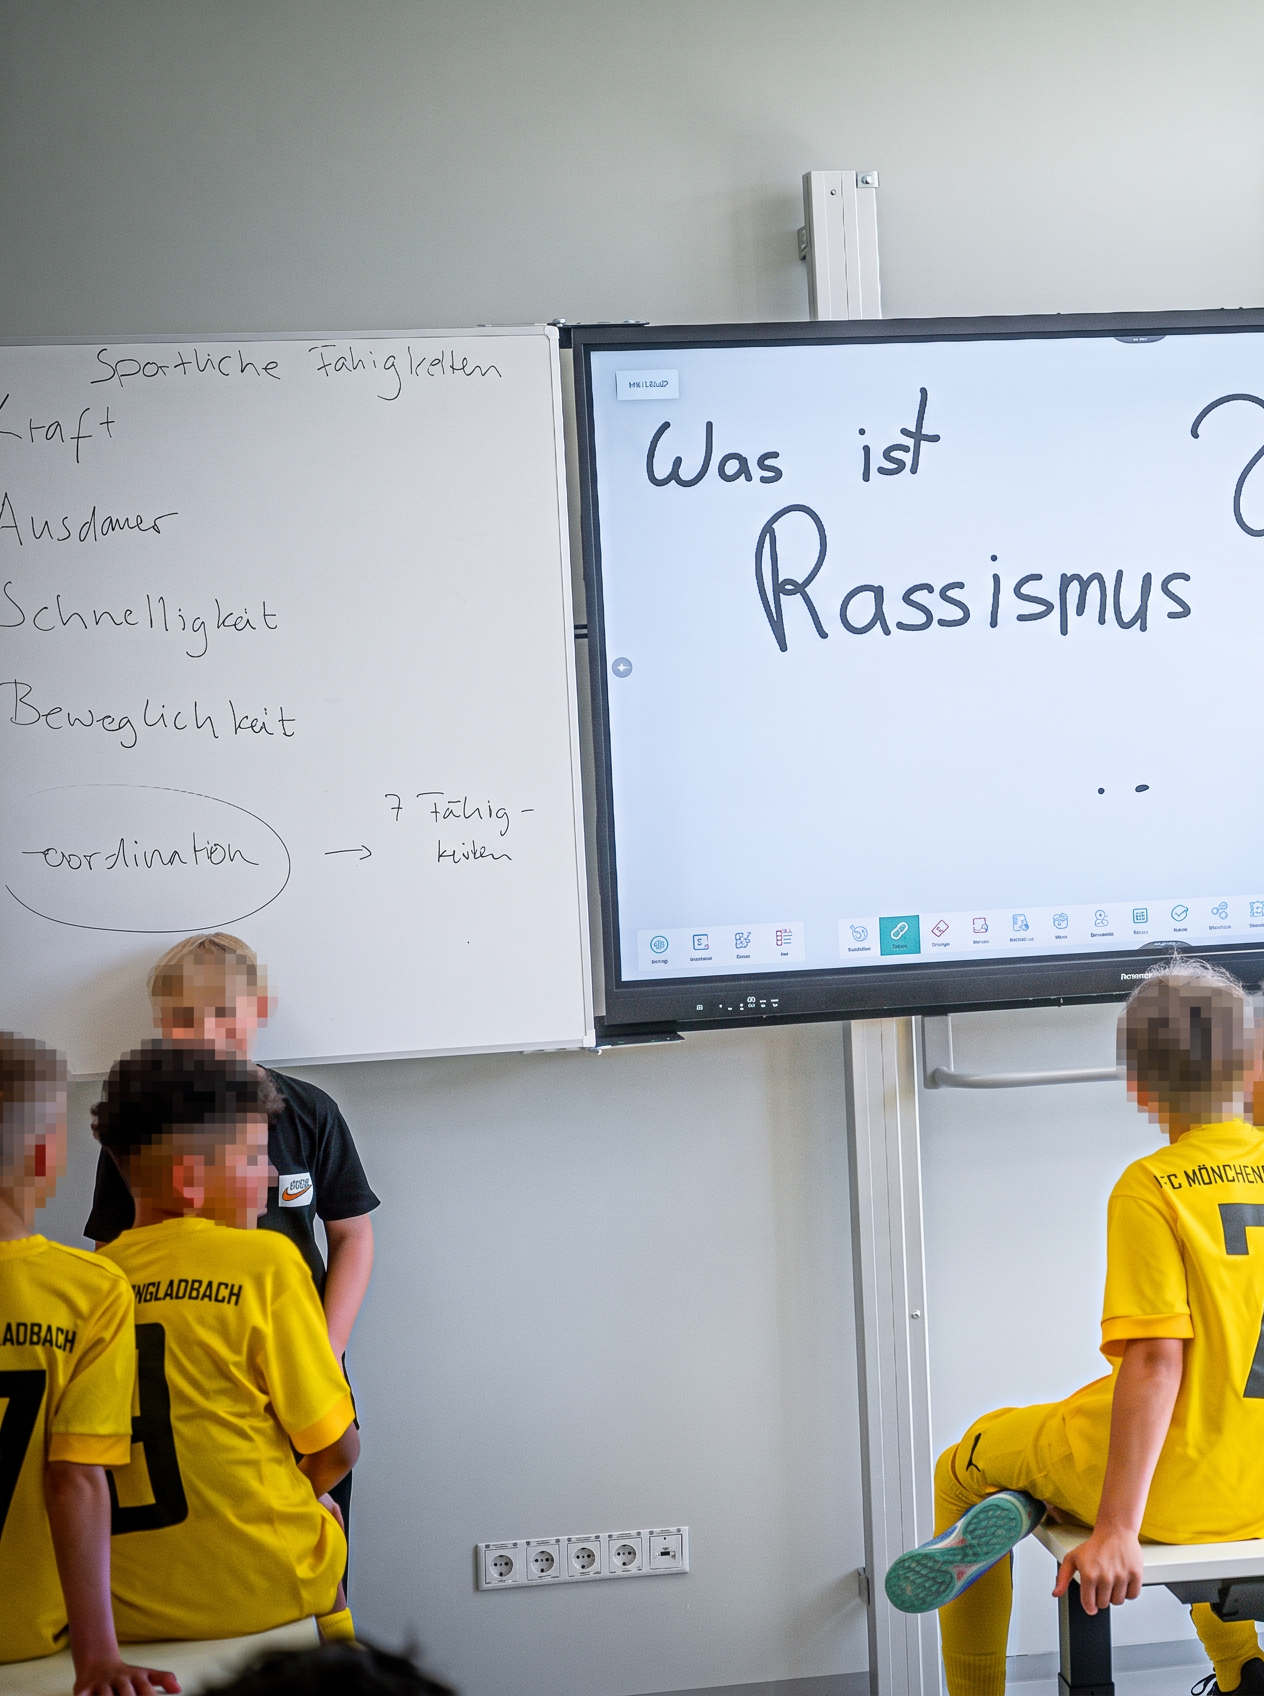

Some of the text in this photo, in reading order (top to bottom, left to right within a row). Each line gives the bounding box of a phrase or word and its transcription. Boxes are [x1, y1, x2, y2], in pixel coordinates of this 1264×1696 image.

[89, 347, 282, 388] Sportliche
[646, 386, 941, 488] Was ist
[755, 503, 1193, 653] Rassismus
[0, 580, 278, 659] Schnelligkeit
[0, 678, 296, 749] Beweglichkeit
